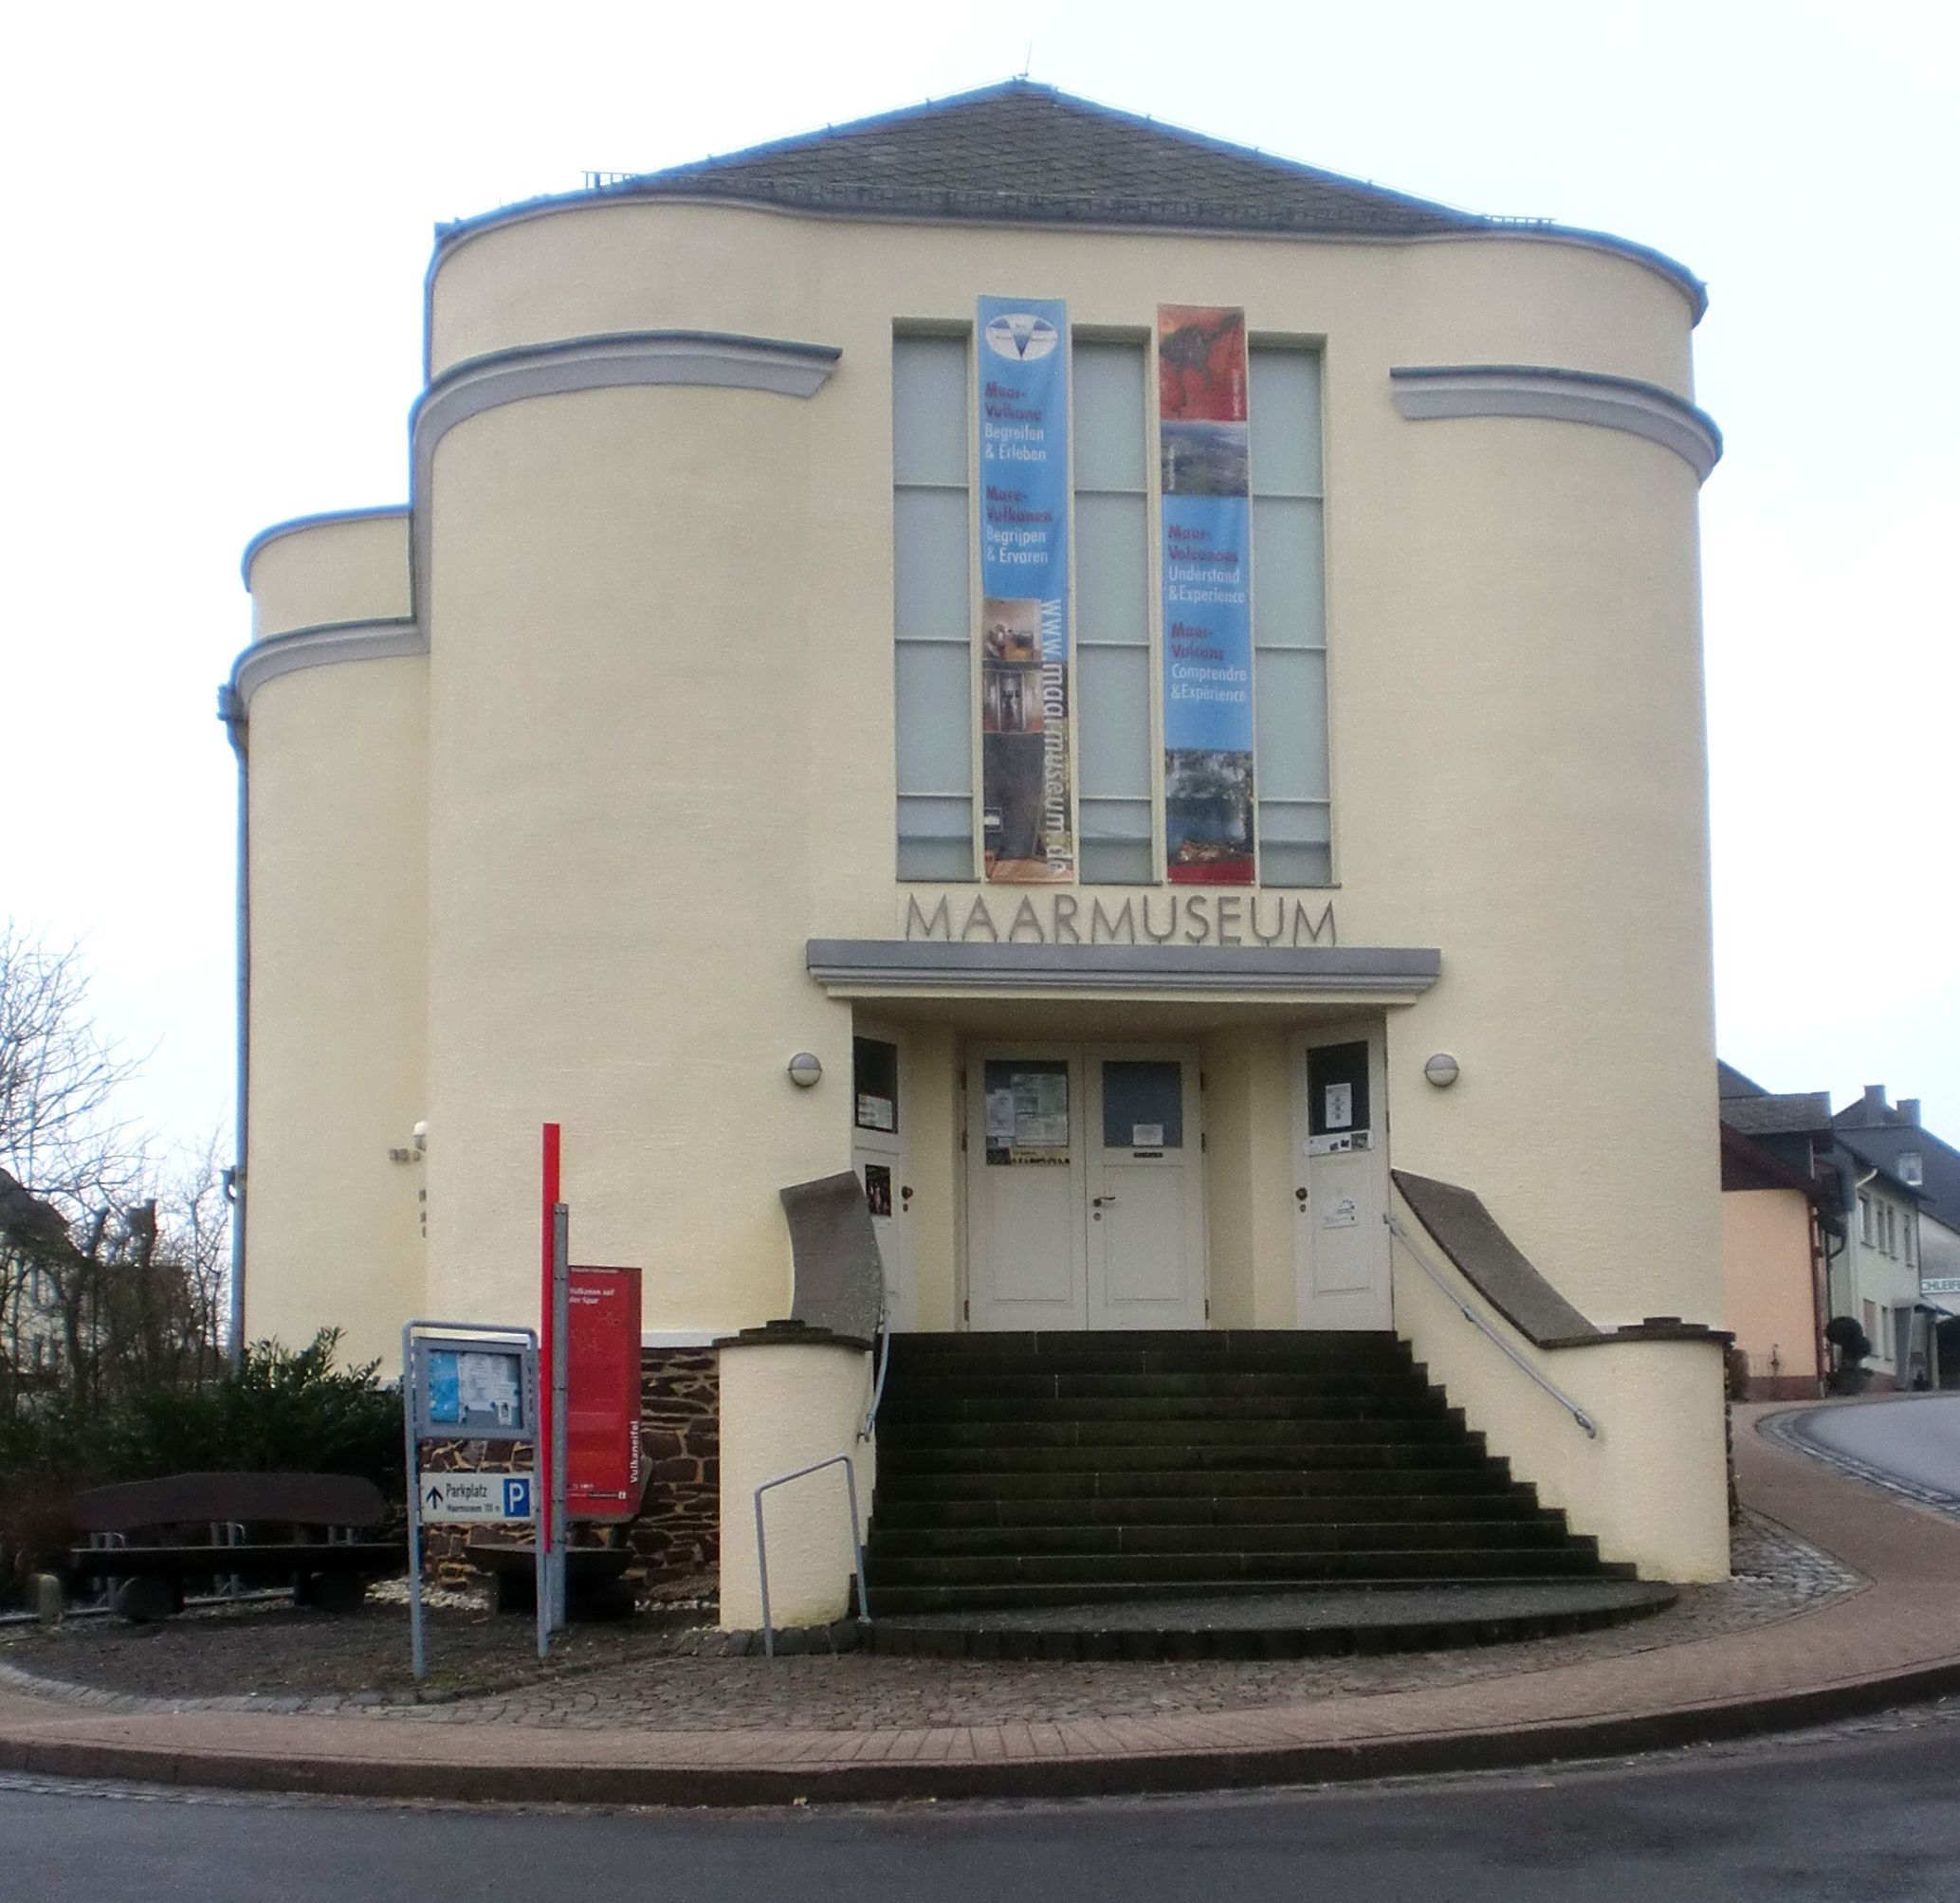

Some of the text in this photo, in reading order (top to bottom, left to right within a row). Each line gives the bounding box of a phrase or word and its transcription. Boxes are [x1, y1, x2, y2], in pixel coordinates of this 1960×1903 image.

[985, 423, 1044, 442] Begreifen
[985, 443, 1046, 461] & Erleben
[986, 525, 1047, 547] Begrijpen
[986, 545, 1048, 563] & Ervaren
[1167, 564, 1240, 583] Understand
[1171, 663, 1248, 683] Comprendre
[1042, 598, 1073, 873] www.maarmuseum.de
[906, 892, 1337, 946] MAARMUSEUM
[630, 1420, 639, 1484] Vulkaneifel
[446, 1483, 487, 1500] Parkplatz
[509, 1482, 524, 1513] P
